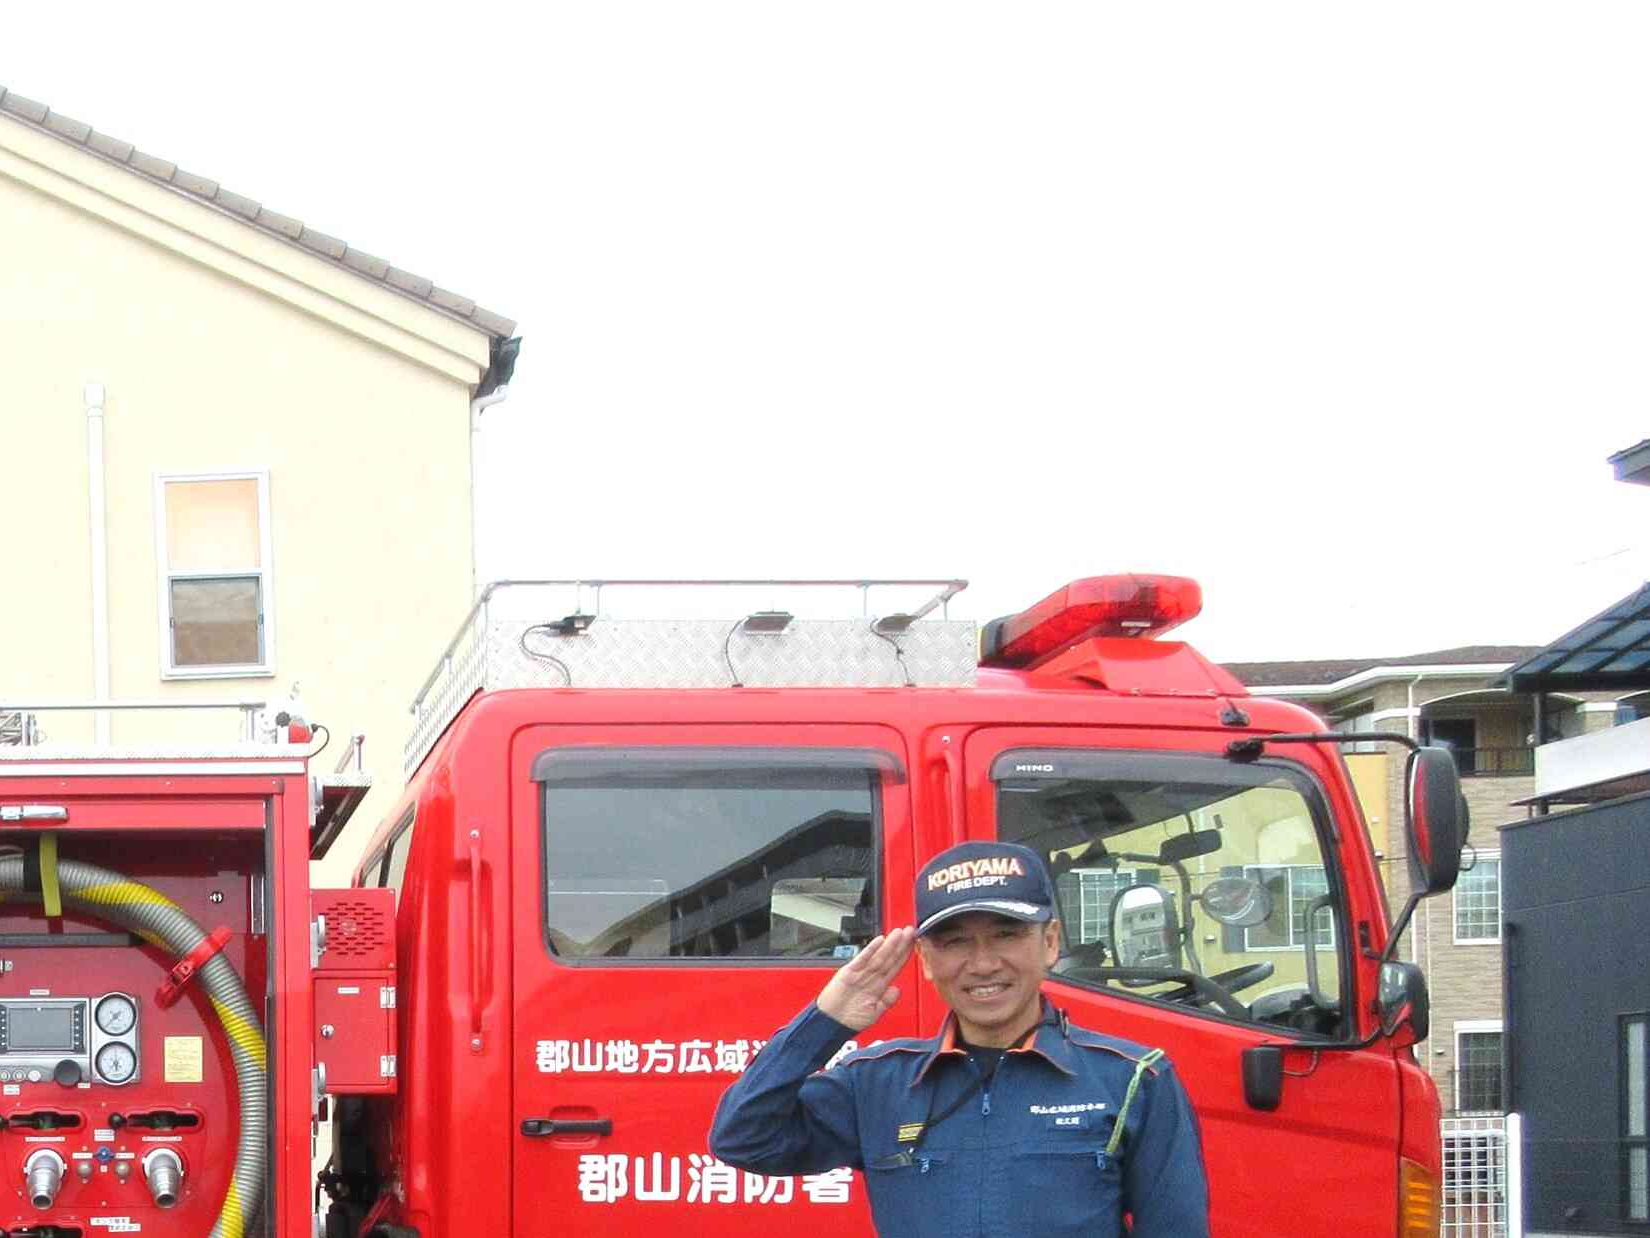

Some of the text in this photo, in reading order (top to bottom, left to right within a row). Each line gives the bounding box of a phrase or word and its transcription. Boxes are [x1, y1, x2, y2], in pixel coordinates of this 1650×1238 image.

[1016, 764, 1055, 772] HINO
[927, 858, 1024, 891] KORIYAMA
[946, 875, 1008, 893] FIRE DEPT.
